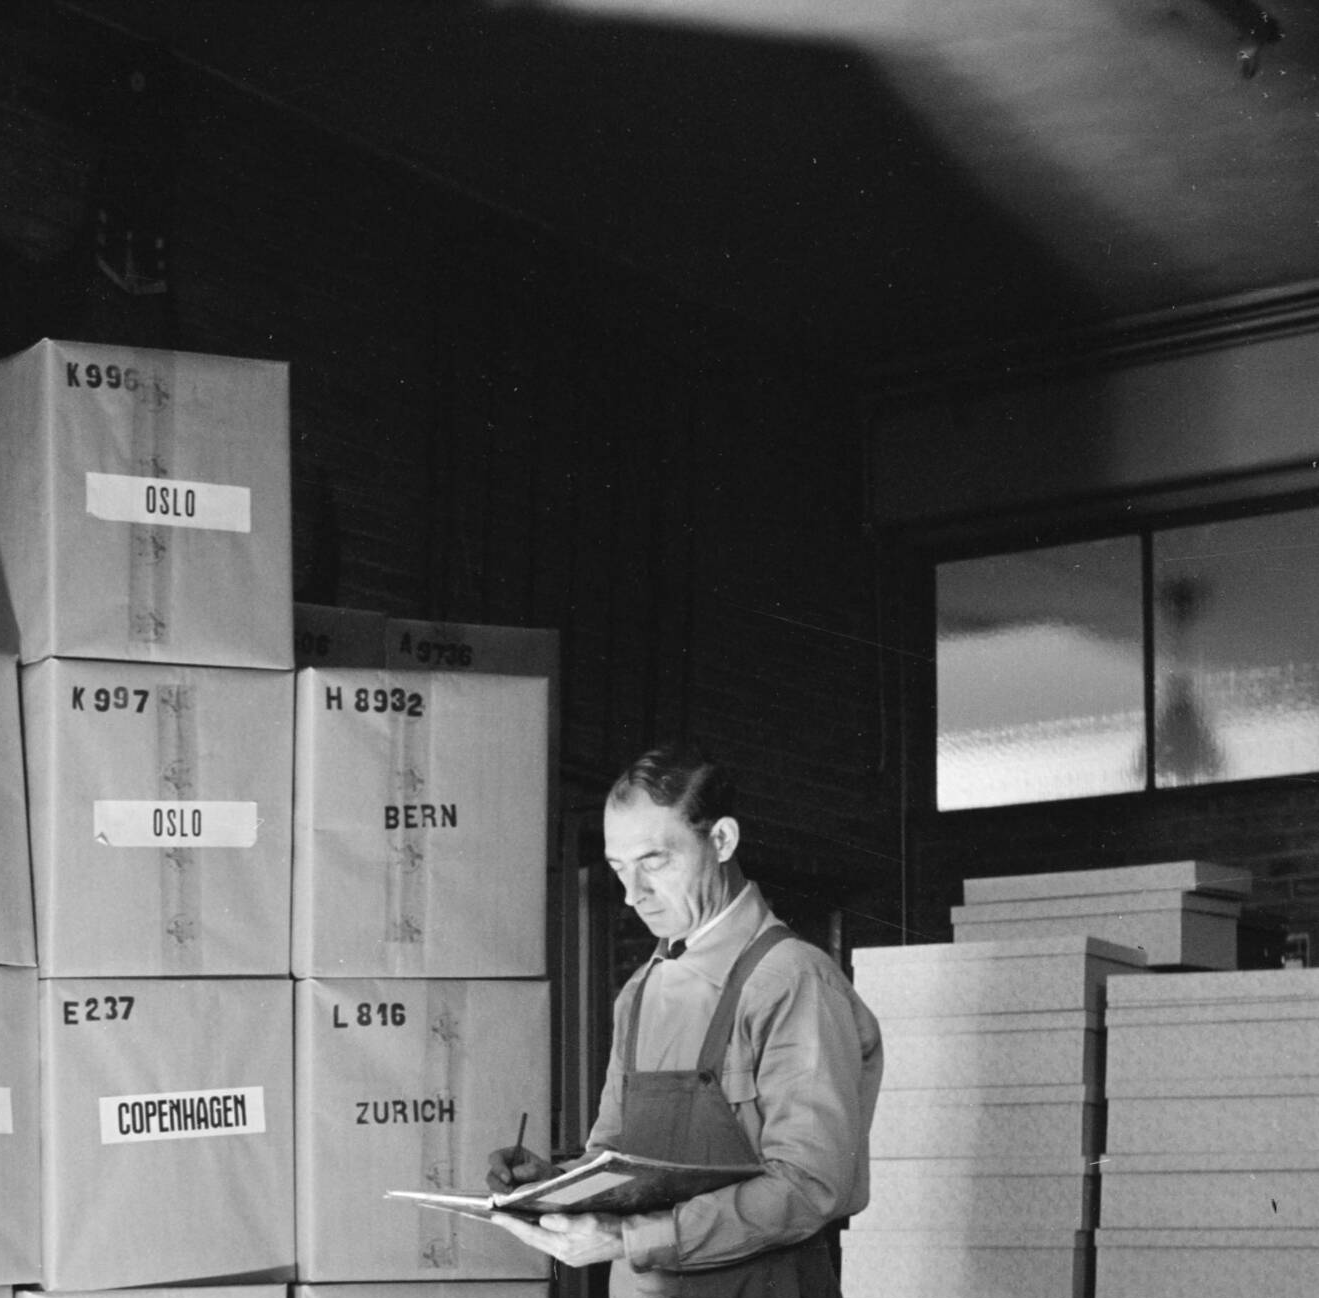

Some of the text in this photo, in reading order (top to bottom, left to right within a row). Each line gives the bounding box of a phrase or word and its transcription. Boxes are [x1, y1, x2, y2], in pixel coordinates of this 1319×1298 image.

[146, 485, 195, 517] OSLO
[325, 686, 425, 717] H 8932
[153, 808, 202, 837] OSLO
[384, 804, 458, 830] BERN
[118, 1094, 247, 1135] COPENHAGEN
[356, 1099, 455, 1125] ZURICH
